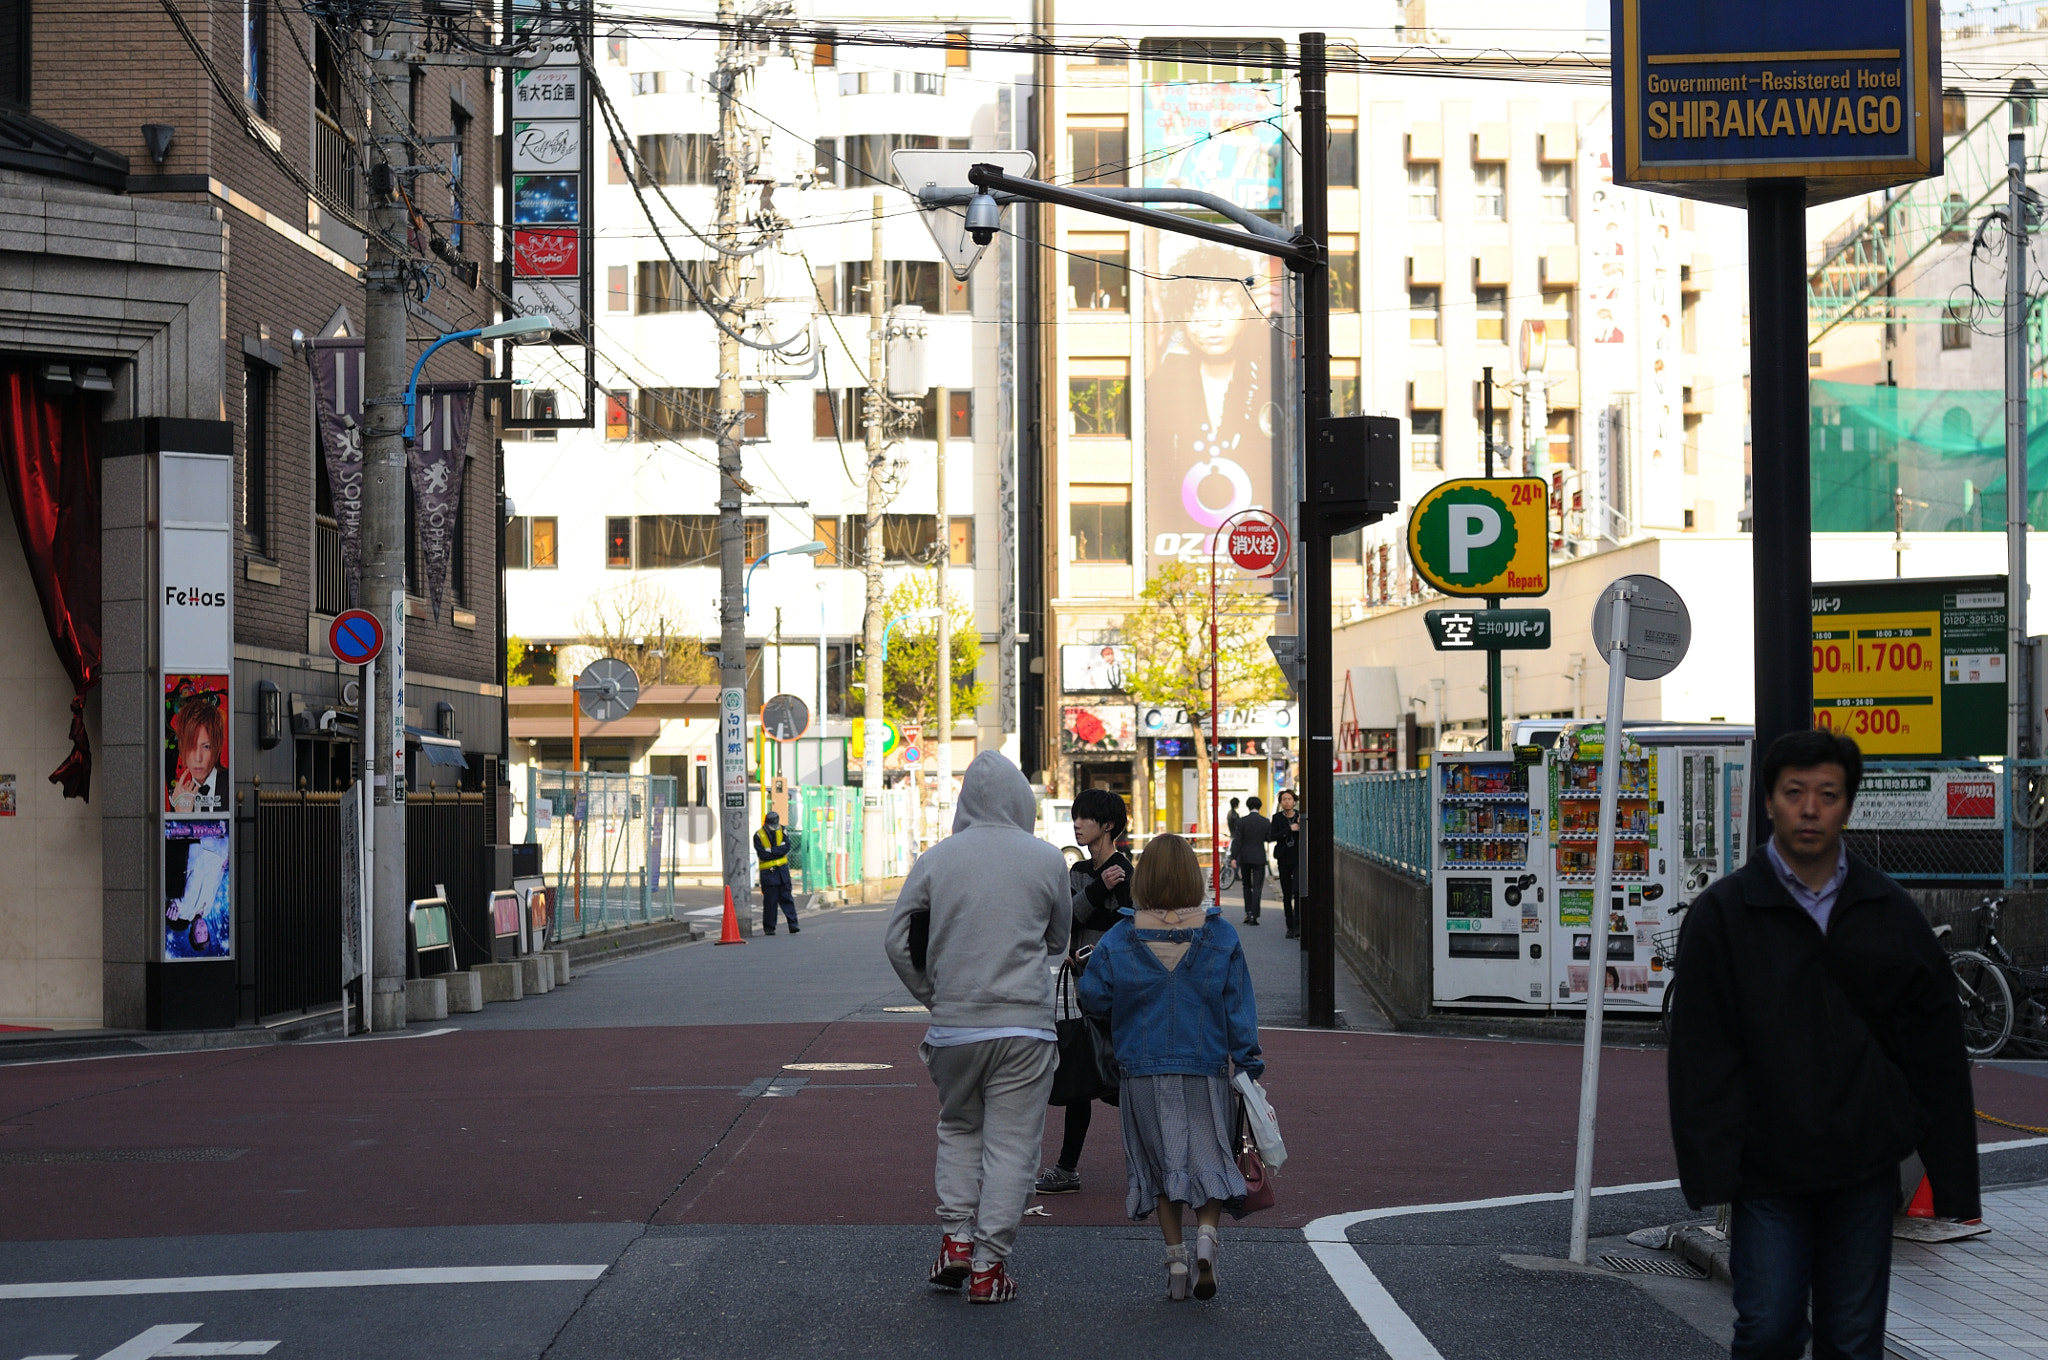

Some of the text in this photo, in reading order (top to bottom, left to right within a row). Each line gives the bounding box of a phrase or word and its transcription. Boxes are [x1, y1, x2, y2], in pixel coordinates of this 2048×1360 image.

[1857, 68, 1900, 89] Hotel
[1648, 95, 1901, 139] SHIRAKAWAGO
[532, 252, 562, 264] Sophia
[426, 500, 449, 560] SOPHIA
[1448, 504, 1502, 574] P
[1232, 535, 1275, 556] 消火栓
[1507, 571, 1544, 590] Repark
[166, 586, 226, 607] Fellas
[1441, 613, 1544, 647] 空 三井のリパーク
